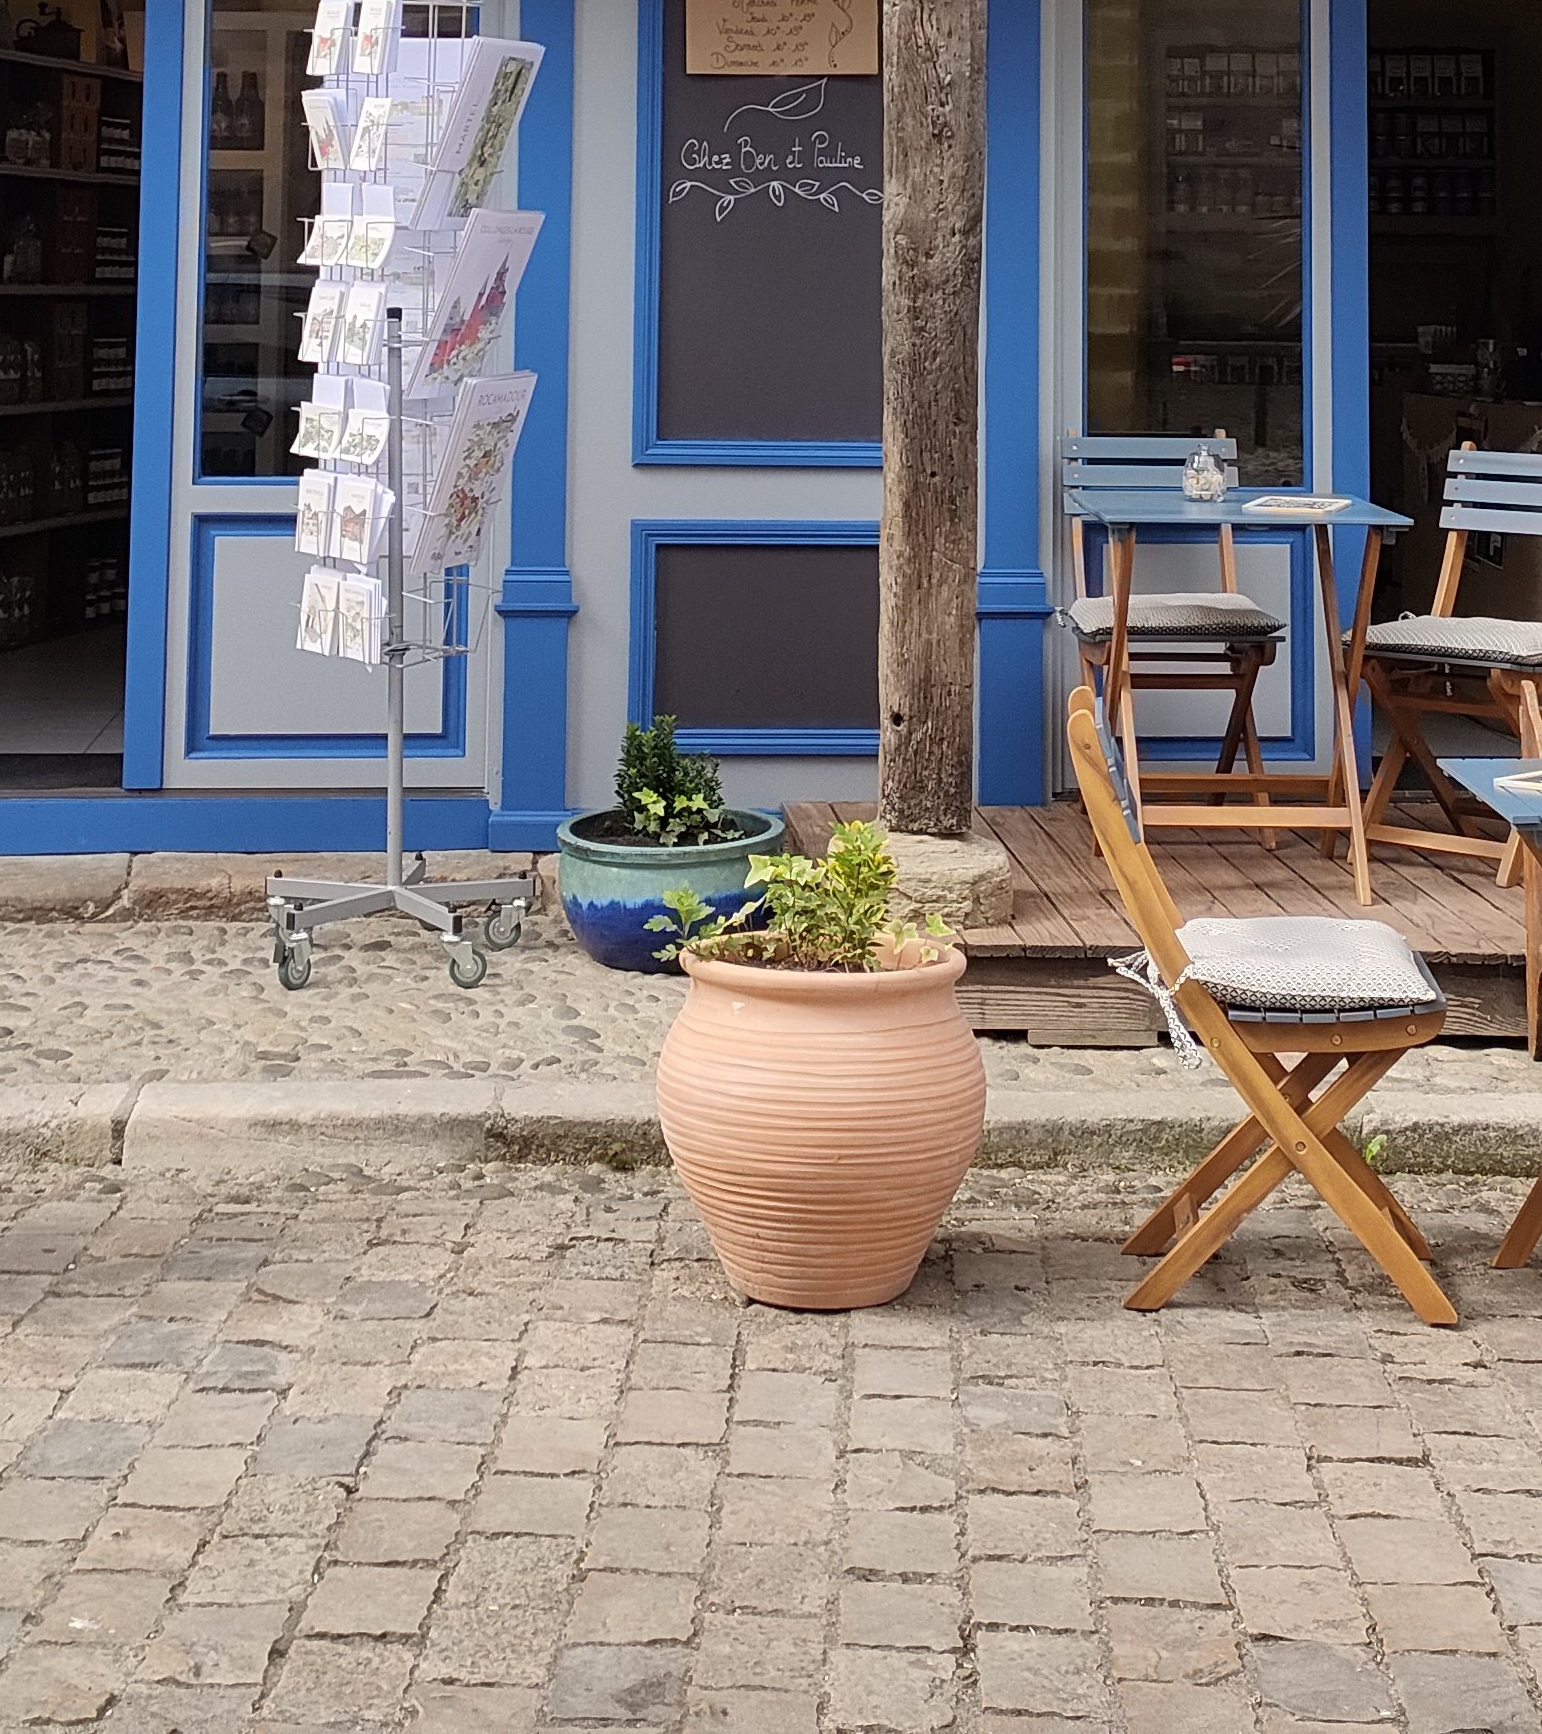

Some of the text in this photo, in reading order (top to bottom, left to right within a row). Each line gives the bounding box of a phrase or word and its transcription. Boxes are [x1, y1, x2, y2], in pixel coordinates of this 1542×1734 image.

[681, 130, 864, 173] Chez Ben et Pauline
